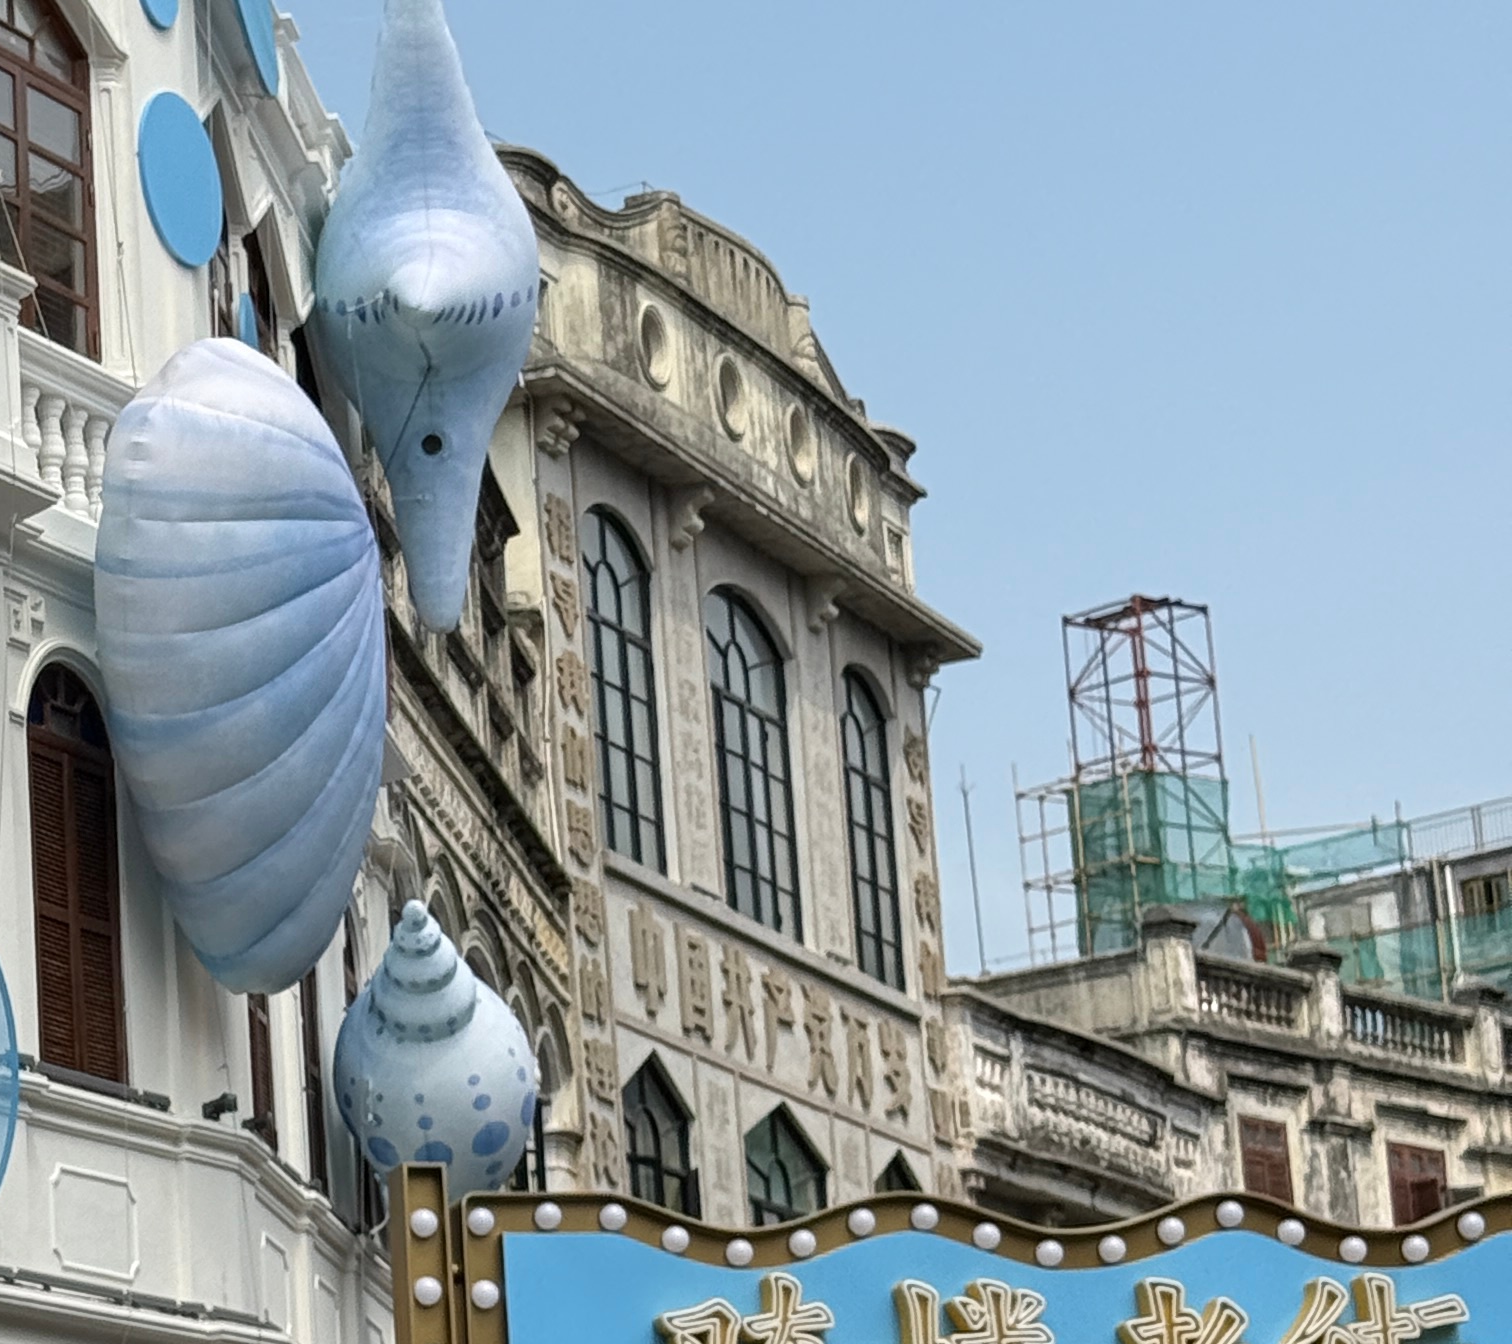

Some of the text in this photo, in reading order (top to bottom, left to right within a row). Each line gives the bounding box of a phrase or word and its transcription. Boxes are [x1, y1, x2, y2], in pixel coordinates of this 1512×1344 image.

[626, 897, 912, 1129] 中国共产党万岁
